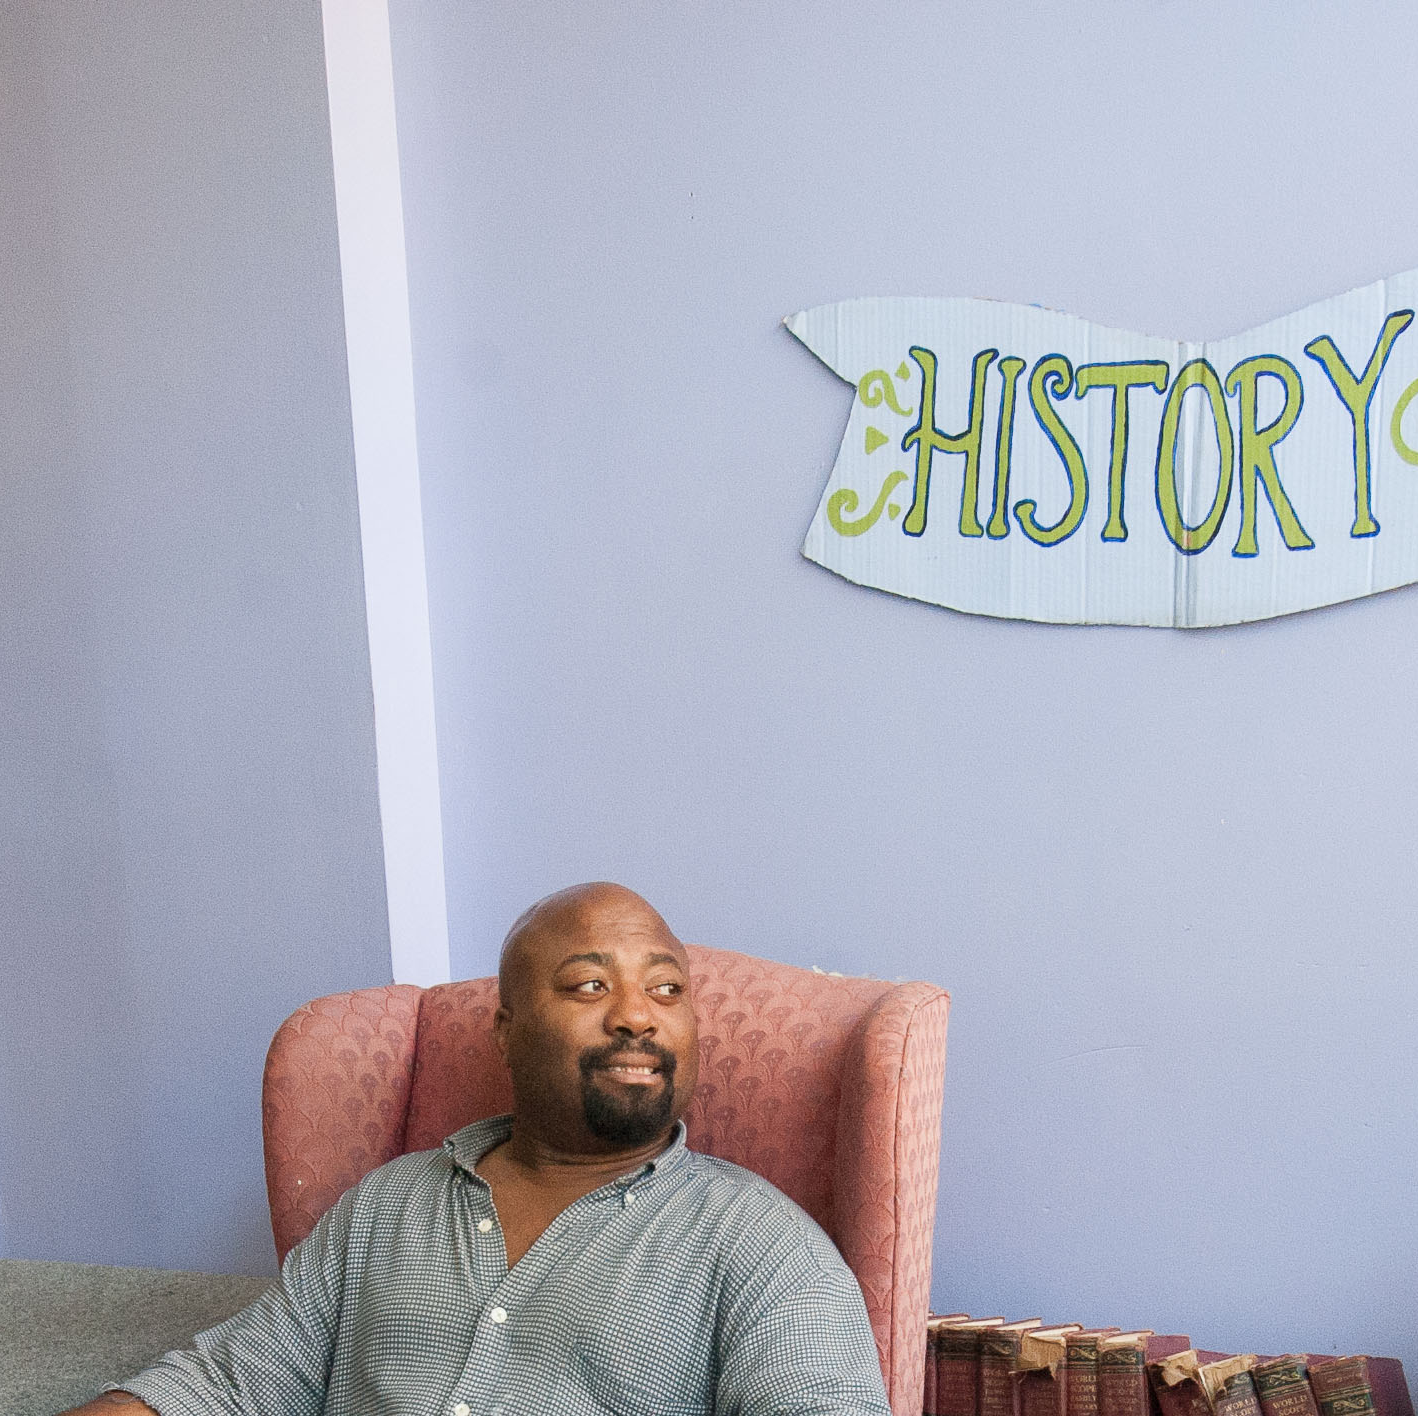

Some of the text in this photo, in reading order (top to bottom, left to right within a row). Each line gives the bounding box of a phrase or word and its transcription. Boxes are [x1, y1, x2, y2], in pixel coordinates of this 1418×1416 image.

[901, 309, 1413, 558] HISTORY
[1272, 1395, 1308, 1409] WORLD
[1278, 1404, 1307, 1416] SCOPE
